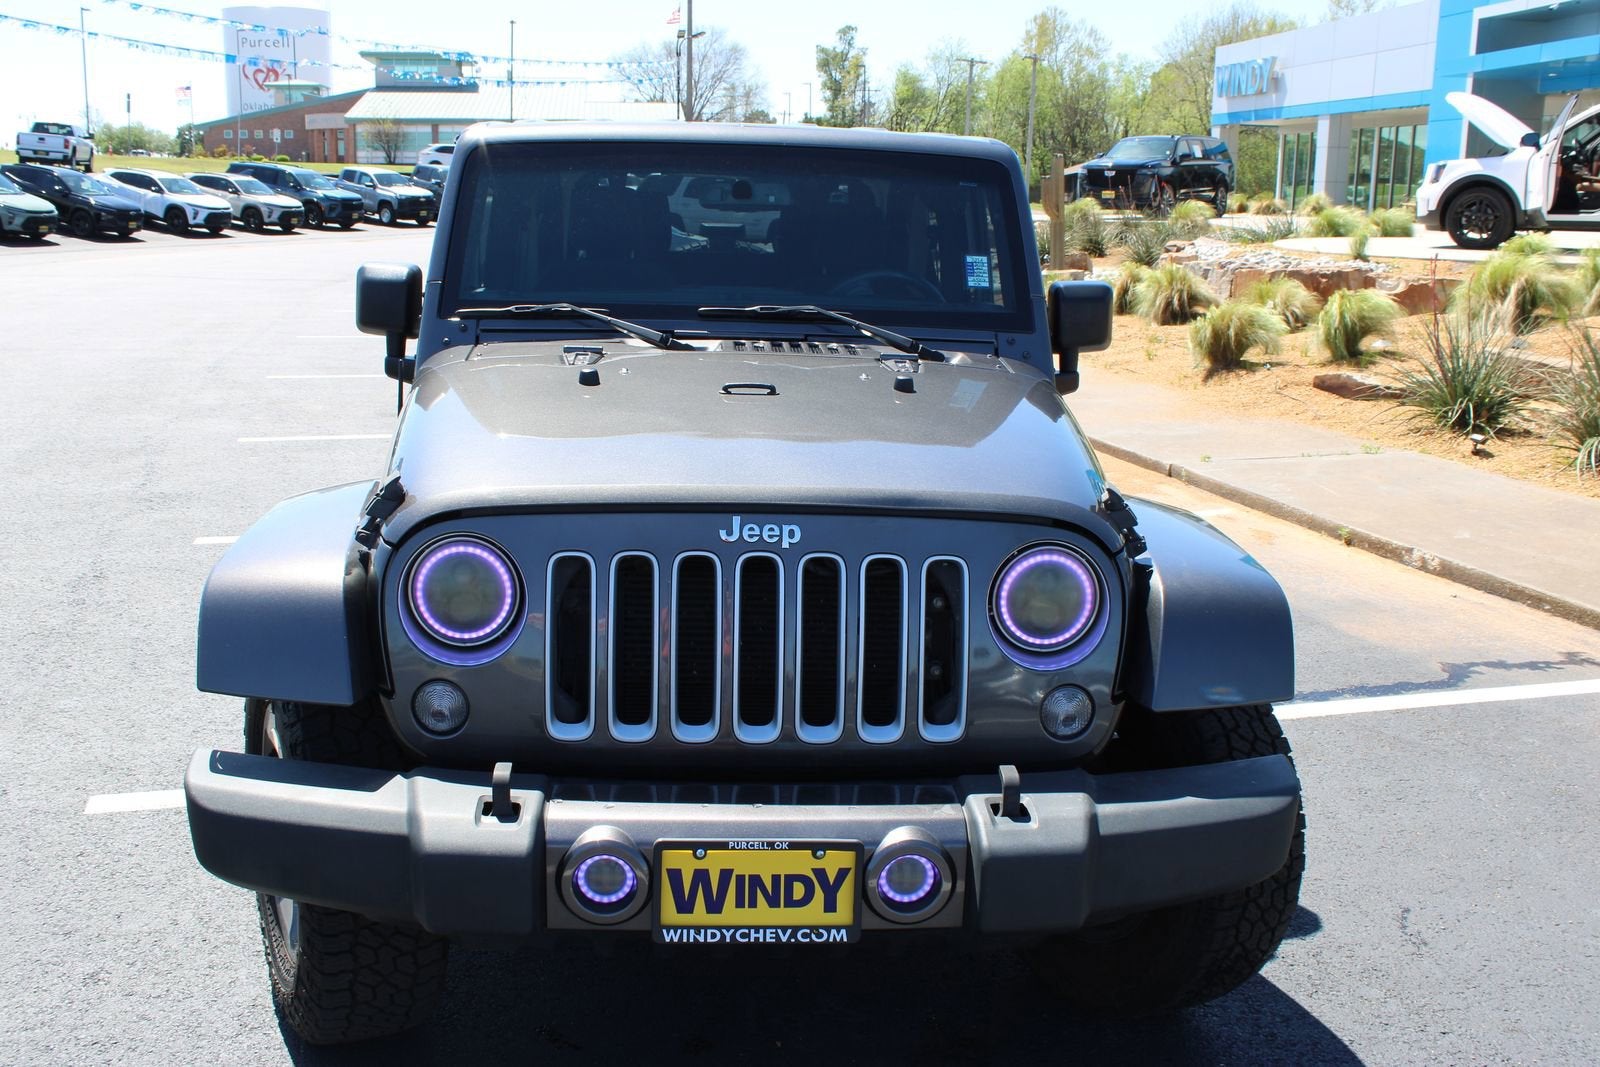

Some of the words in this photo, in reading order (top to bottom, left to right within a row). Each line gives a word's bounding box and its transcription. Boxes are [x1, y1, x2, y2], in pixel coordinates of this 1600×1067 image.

[241, 36, 290, 48] Purcell
[1216, 57, 1276, 98] WINDY
[719, 515, 802, 549] Jeep
[728, 841, 771, 851] PURCELL,
[775, 841, 789, 850] OK
[665, 868, 852, 914] WINDY
[662, 928, 848, 943] WINDYCHEV.COM
